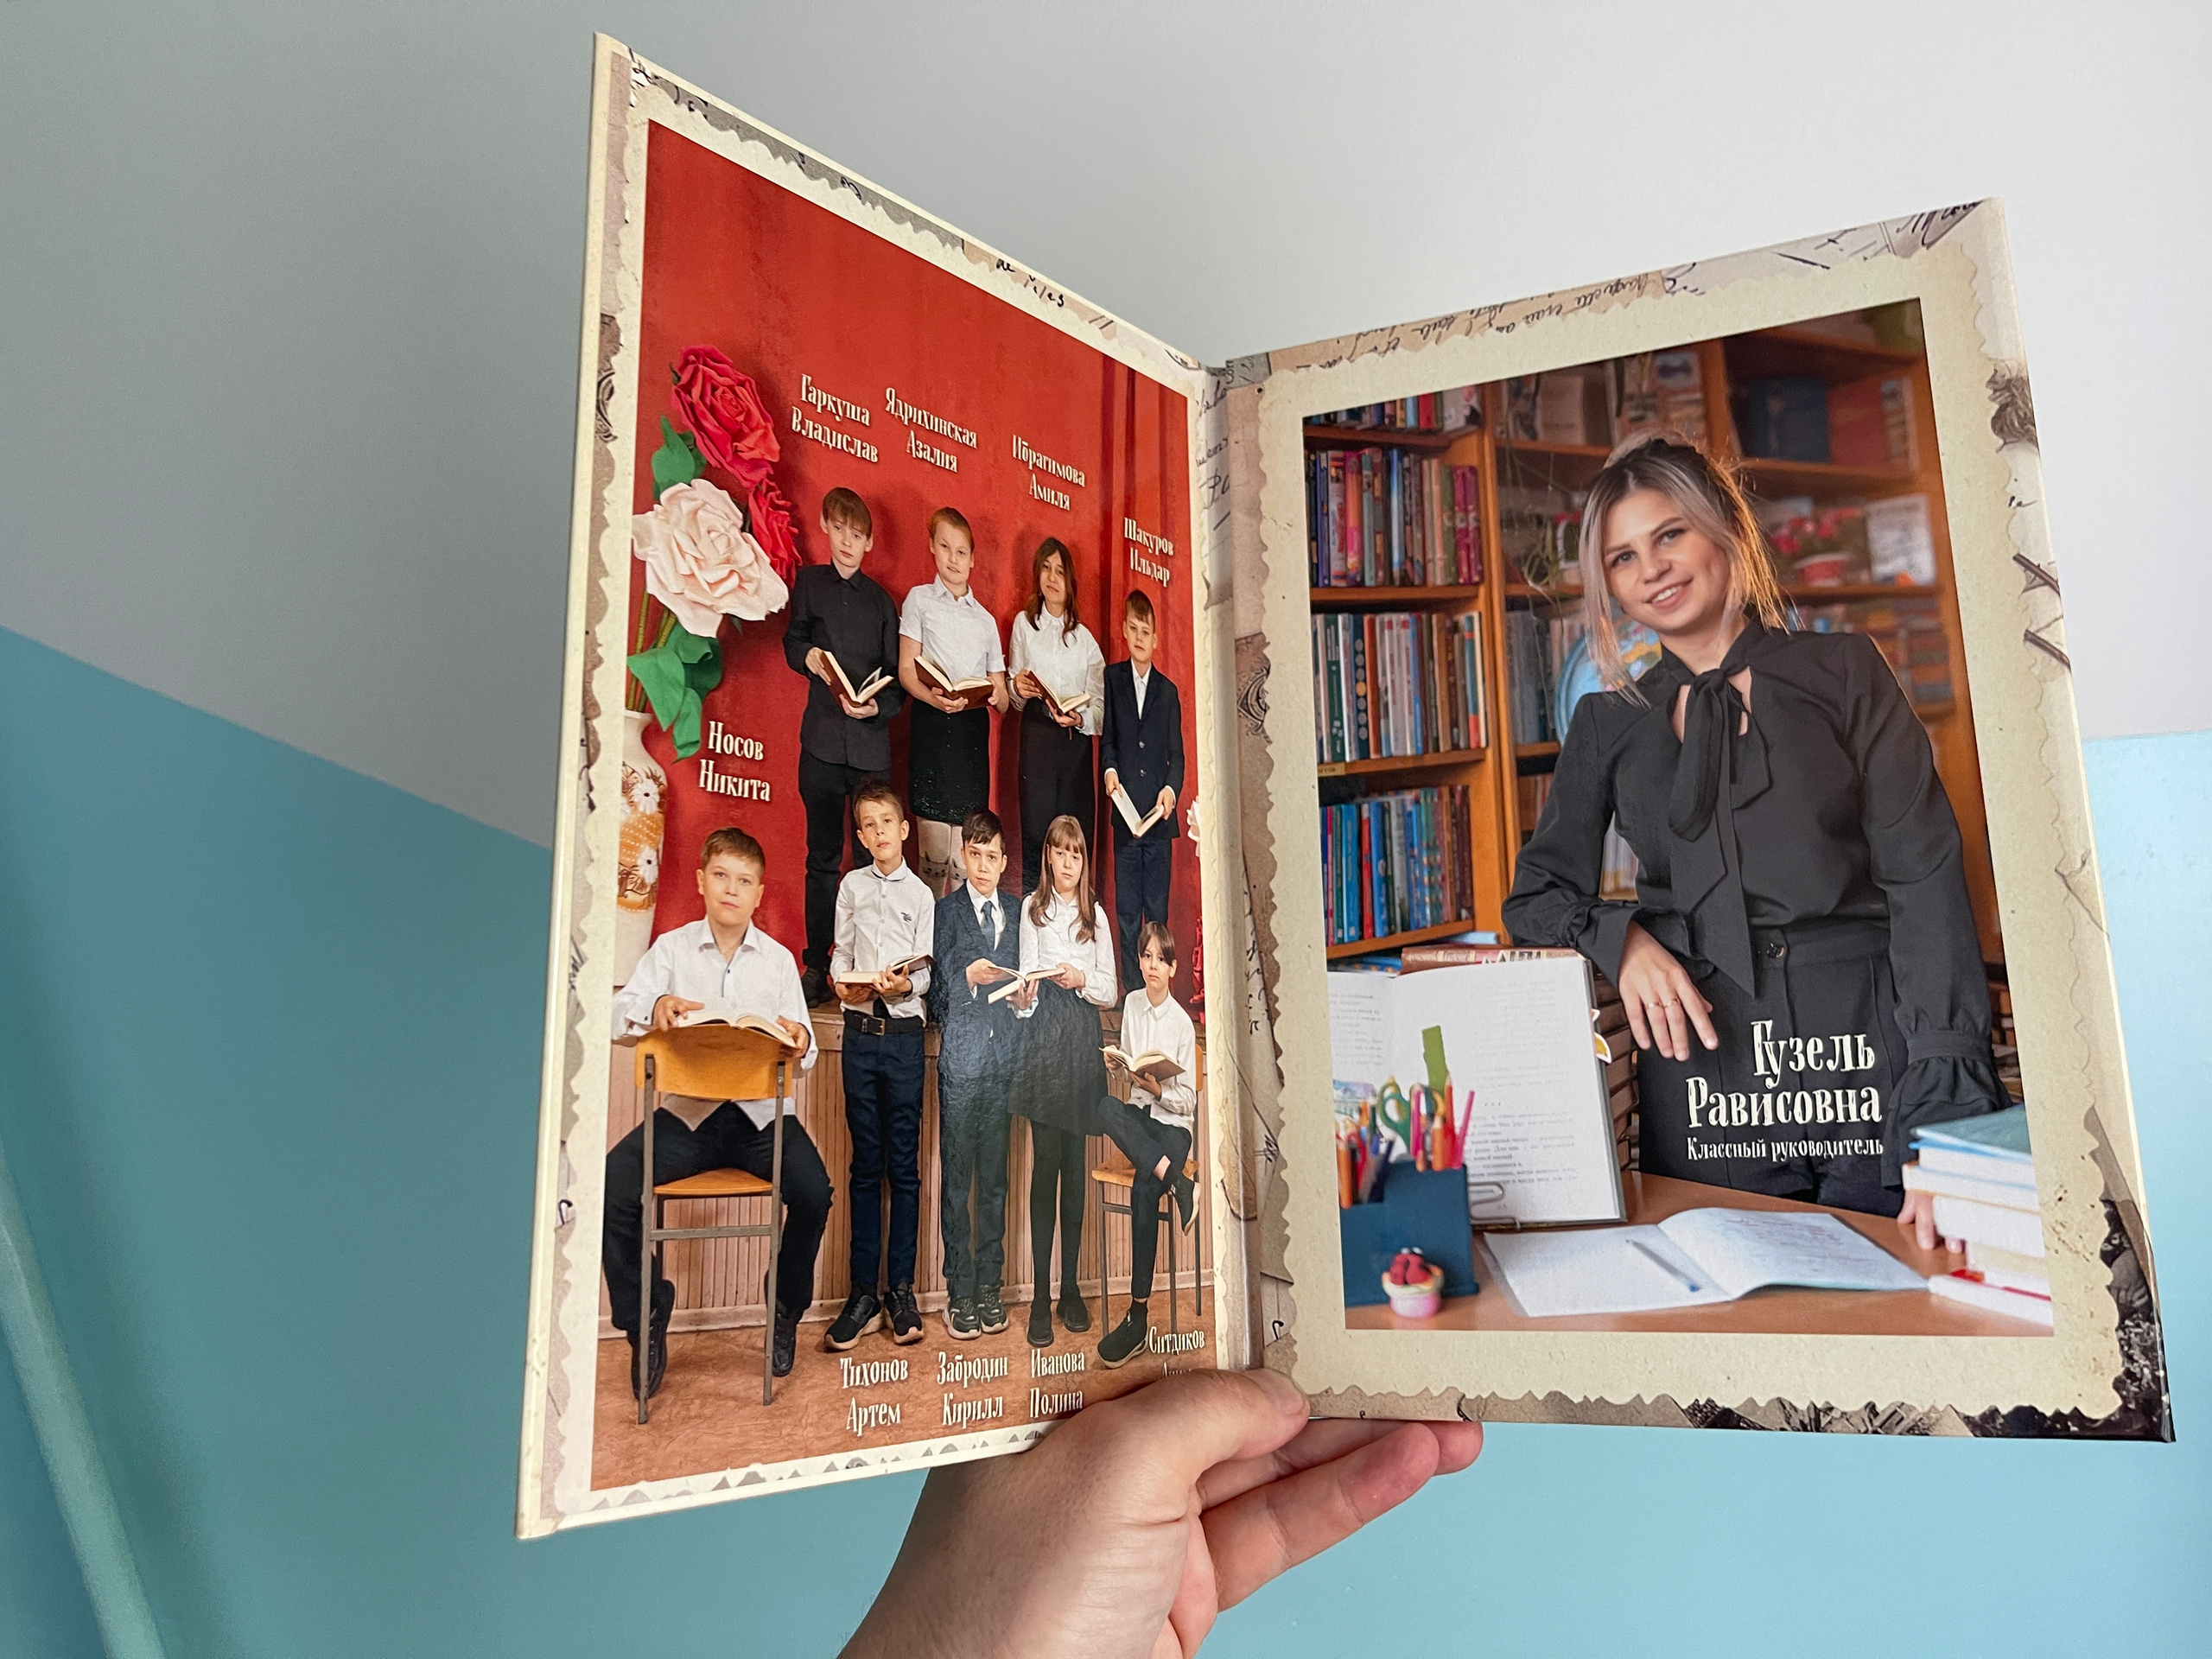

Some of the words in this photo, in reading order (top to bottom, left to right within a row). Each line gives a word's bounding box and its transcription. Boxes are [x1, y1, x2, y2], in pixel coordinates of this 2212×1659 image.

[800, 373, 870, 427] Гаркуша
[885, 386, 978, 449] Ядрихинская
[791, 406, 879, 464] Владислав
[906, 429, 958, 474] Азалия
[1012, 435, 1086, 487] Ибрагимова
[1028, 474, 1071, 512] Амиля
[1123, 517, 1174, 556] Шакуров
[1129, 547, 1170, 588] Ильдар
[708, 721, 764, 760] Носов
[698, 759, 771, 802] Никита
[1750, 1019, 1875, 1090] Гузель
[1685, 1076, 1883, 1128] Рависовна
[1687, 1136, 1766, 1160] Классный
[1771, 1138, 1884, 1163] руководитель
[1148, 1325, 1205, 1356] Ситдиков
[840, 1357, 909, 1389] Тихонов
[937, 1351, 1009, 1388] Забродин
[1030, 1348, 1085, 1379] Иванова
[846, 1396, 902, 1437] Артем
[941, 1391, 1005, 1429] Кирилл
[1029, 1388, 1084, 1418] Полина
